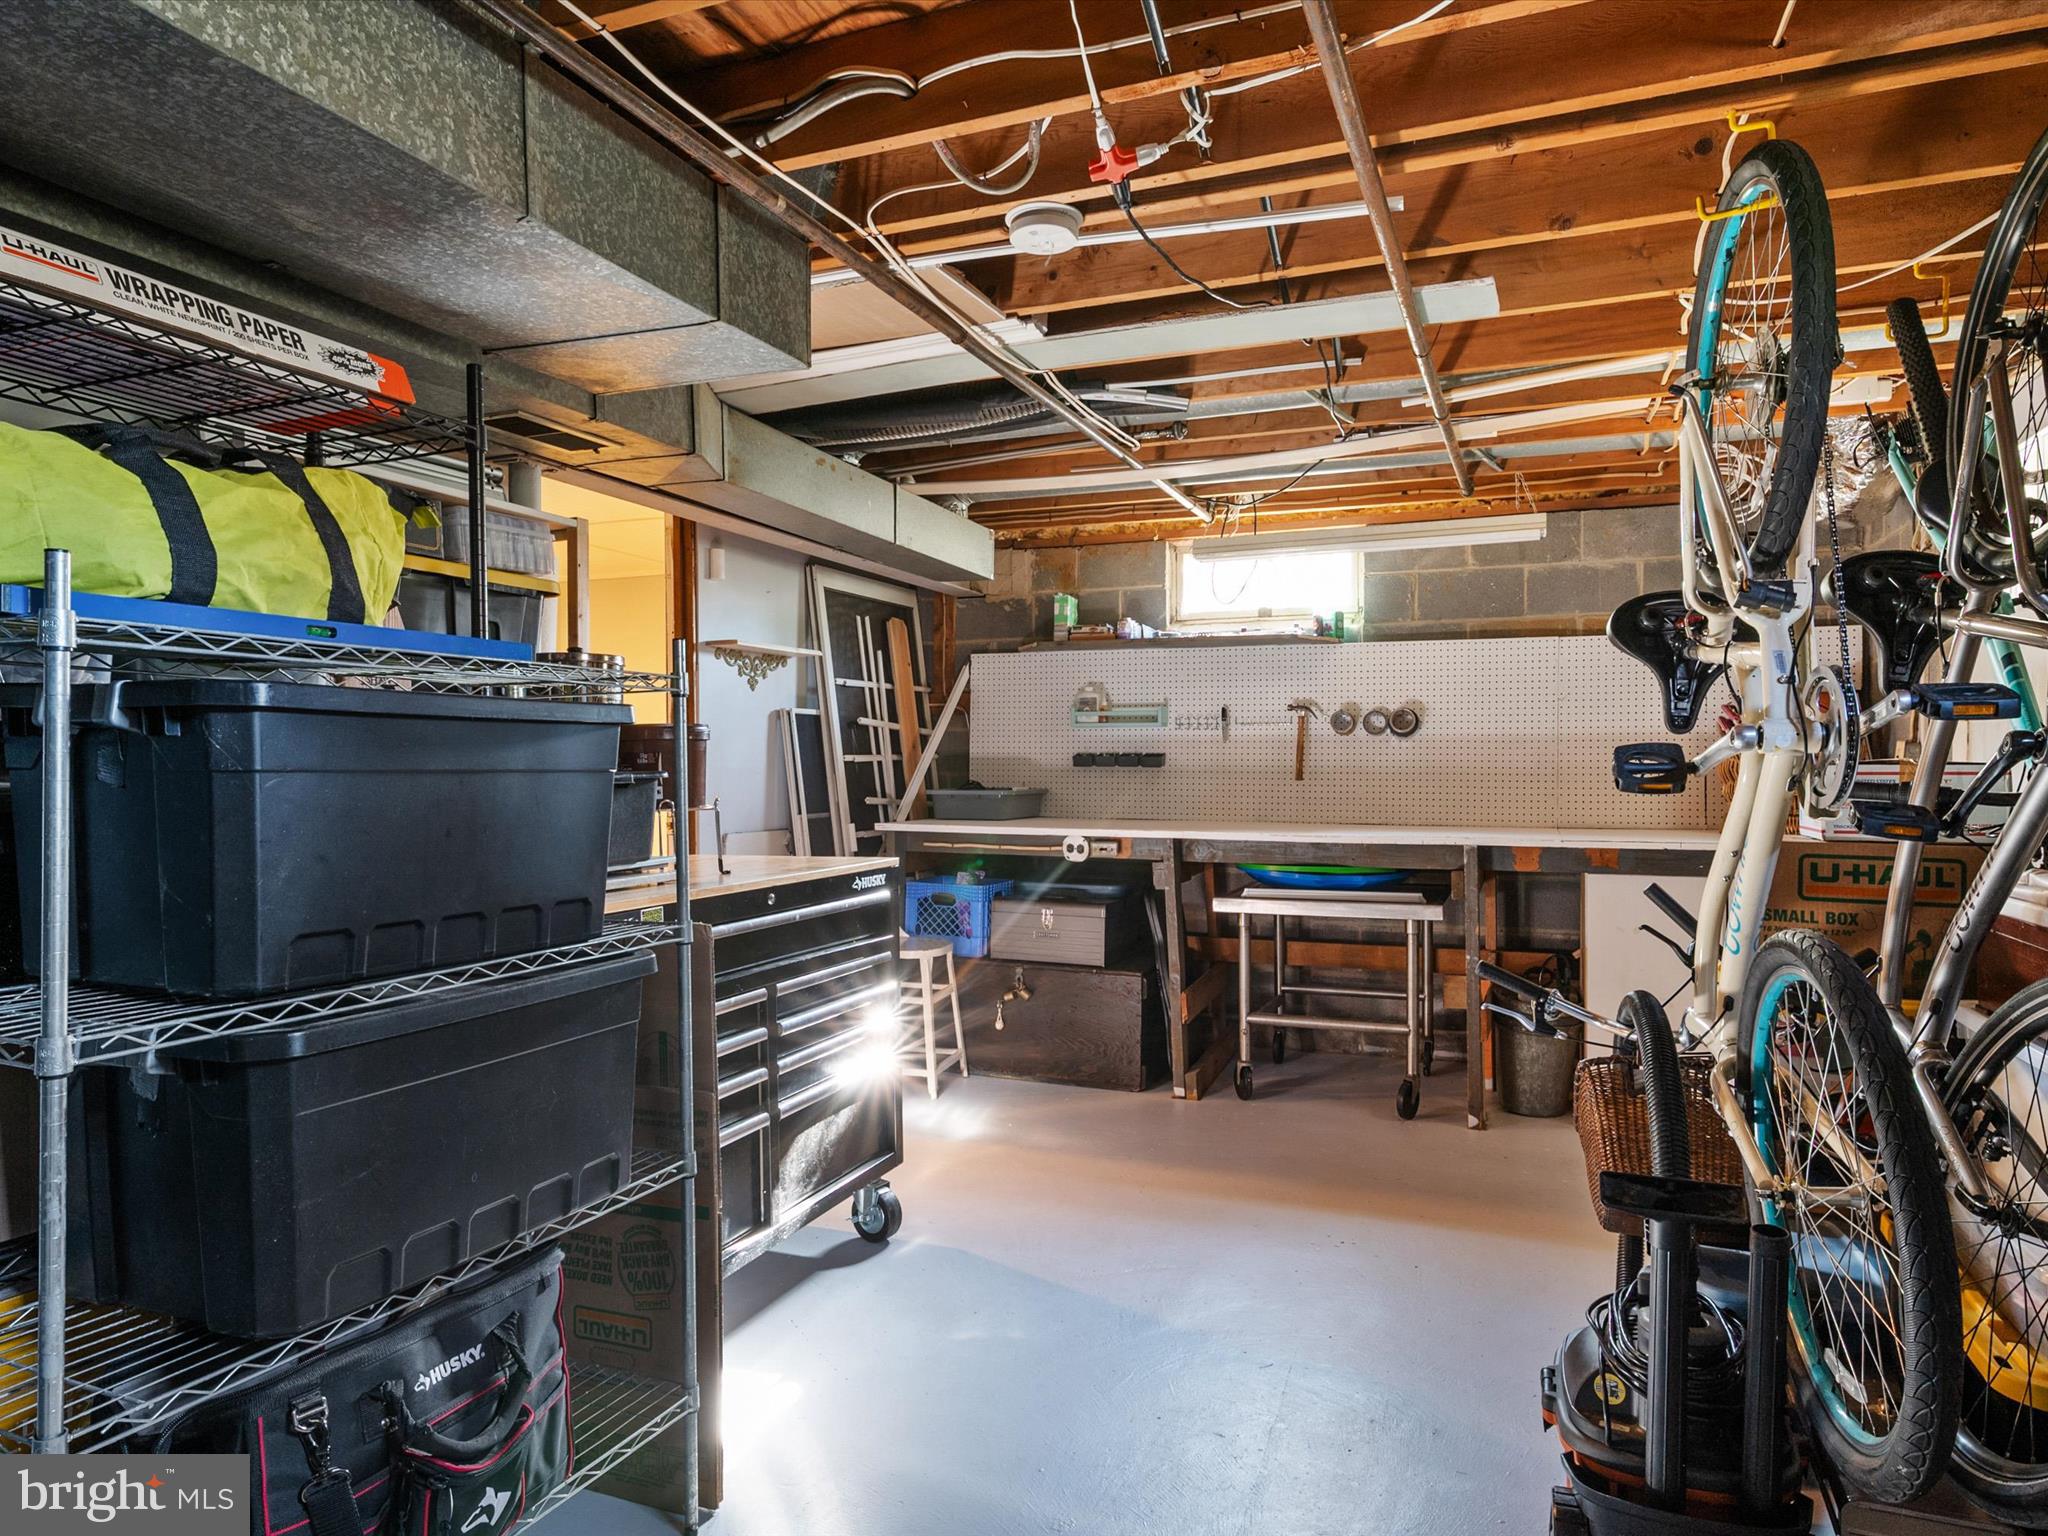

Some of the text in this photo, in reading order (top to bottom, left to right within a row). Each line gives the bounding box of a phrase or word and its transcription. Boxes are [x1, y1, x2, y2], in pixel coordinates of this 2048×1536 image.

[1, 234, 96, 275] U-HAUL
[104, 266, 307, 352] WRAPPING PAPER
[113, 291, 147, 307] CLEAN,
[148, 303, 176, 317] WHITE
[177, 311, 226, 333] NEWSPRINT
[247, 335, 277, 350] SHEETS
[278, 346, 293, 356] PER
[294, 351, 310, 361] BOX
[861, 873, 887, 889] HUSKY
[1763, 908, 1859, 927] SMALL BOX
[565, 1256, 590, 1268] PLENT
[628, 1270, 670, 1292] 100%
[578, 1318, 647, 1345] U-HAUL
[429, 1343, 482, 1385] HUSKY
